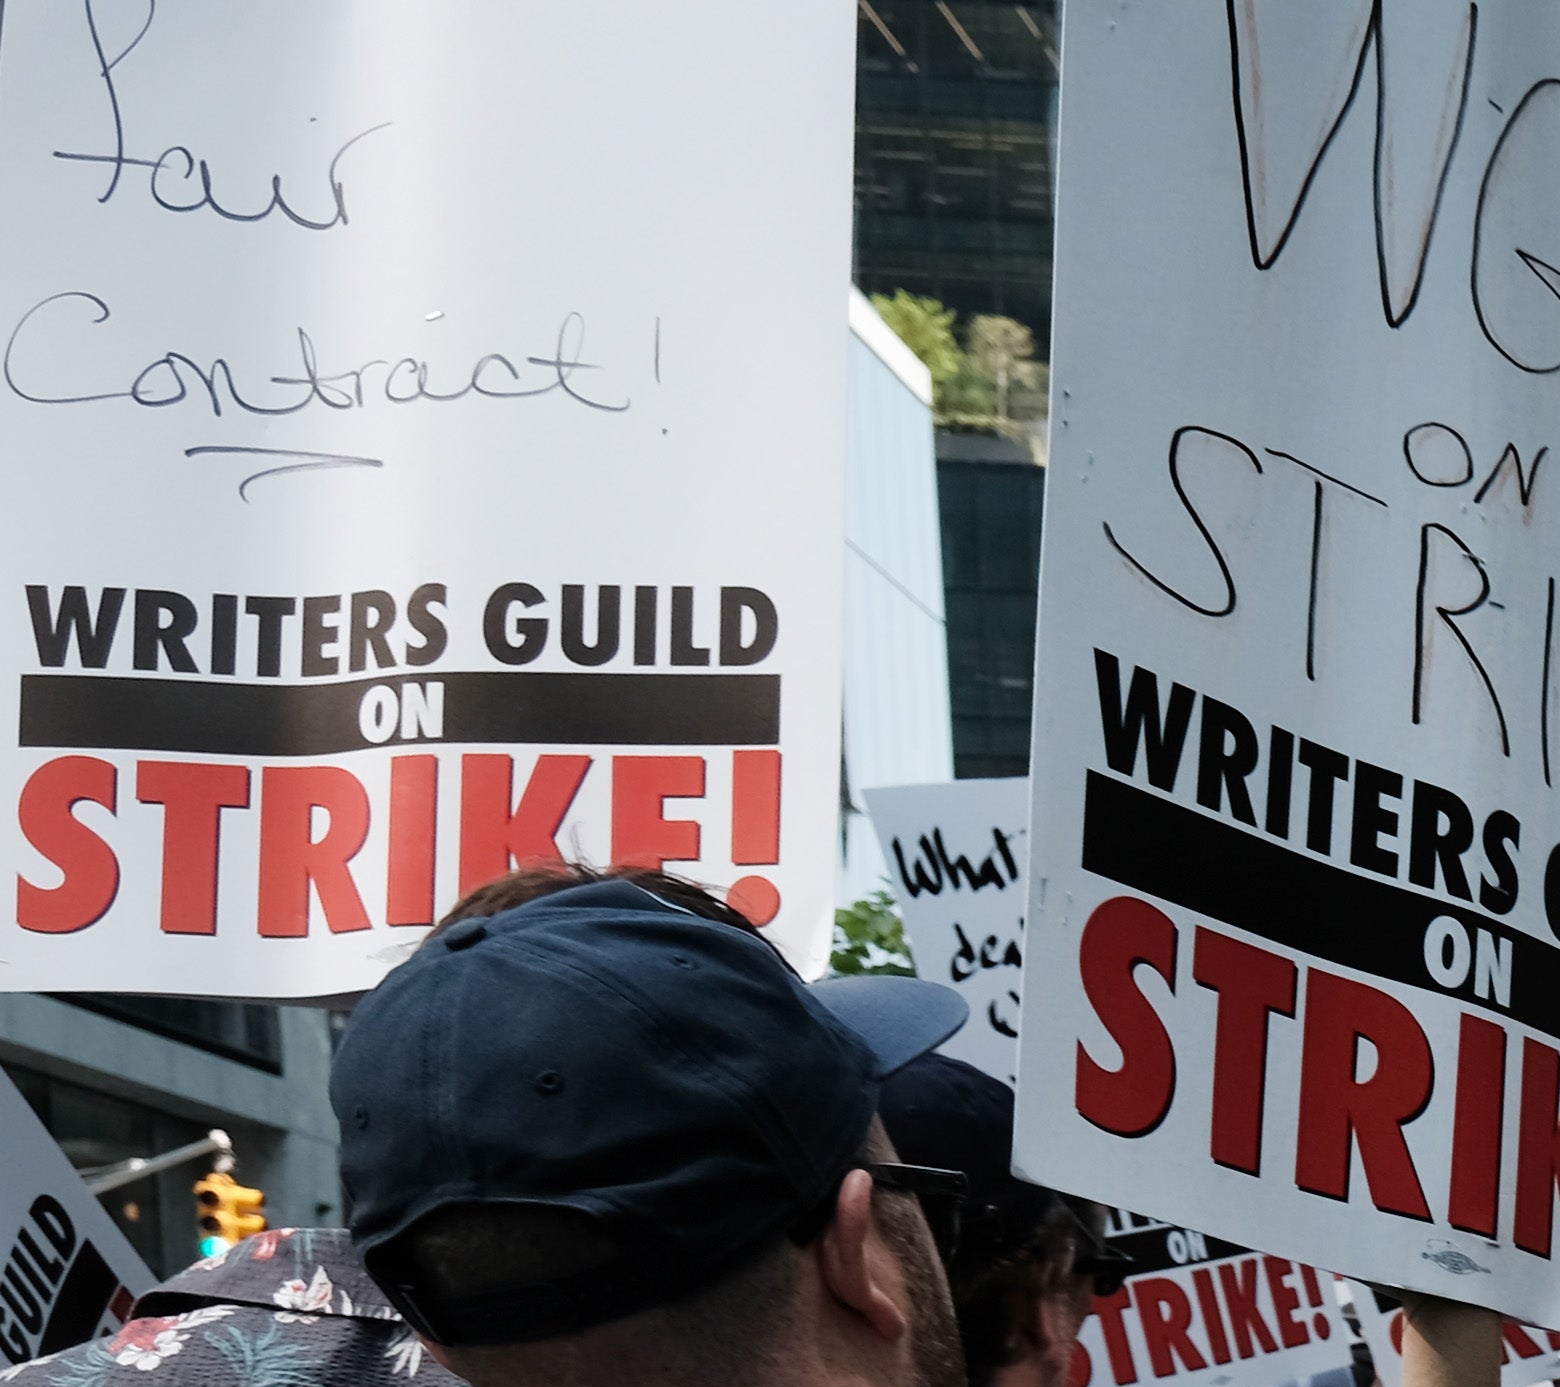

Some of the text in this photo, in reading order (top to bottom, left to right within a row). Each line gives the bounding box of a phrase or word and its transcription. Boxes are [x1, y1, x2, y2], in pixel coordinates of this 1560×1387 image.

[1403, 421, 1549, 508] ON
[26, 582, 780, 676] WRITERS GUILD
[357, 680, 445, 744] ON
[1090, 647, 1524, 917] WRITERS
[16, 749, 784, 939] STRIKE!
[1423, 913, 1513, 1008] ON
[1167, 1230, 1210, 1265] ON
